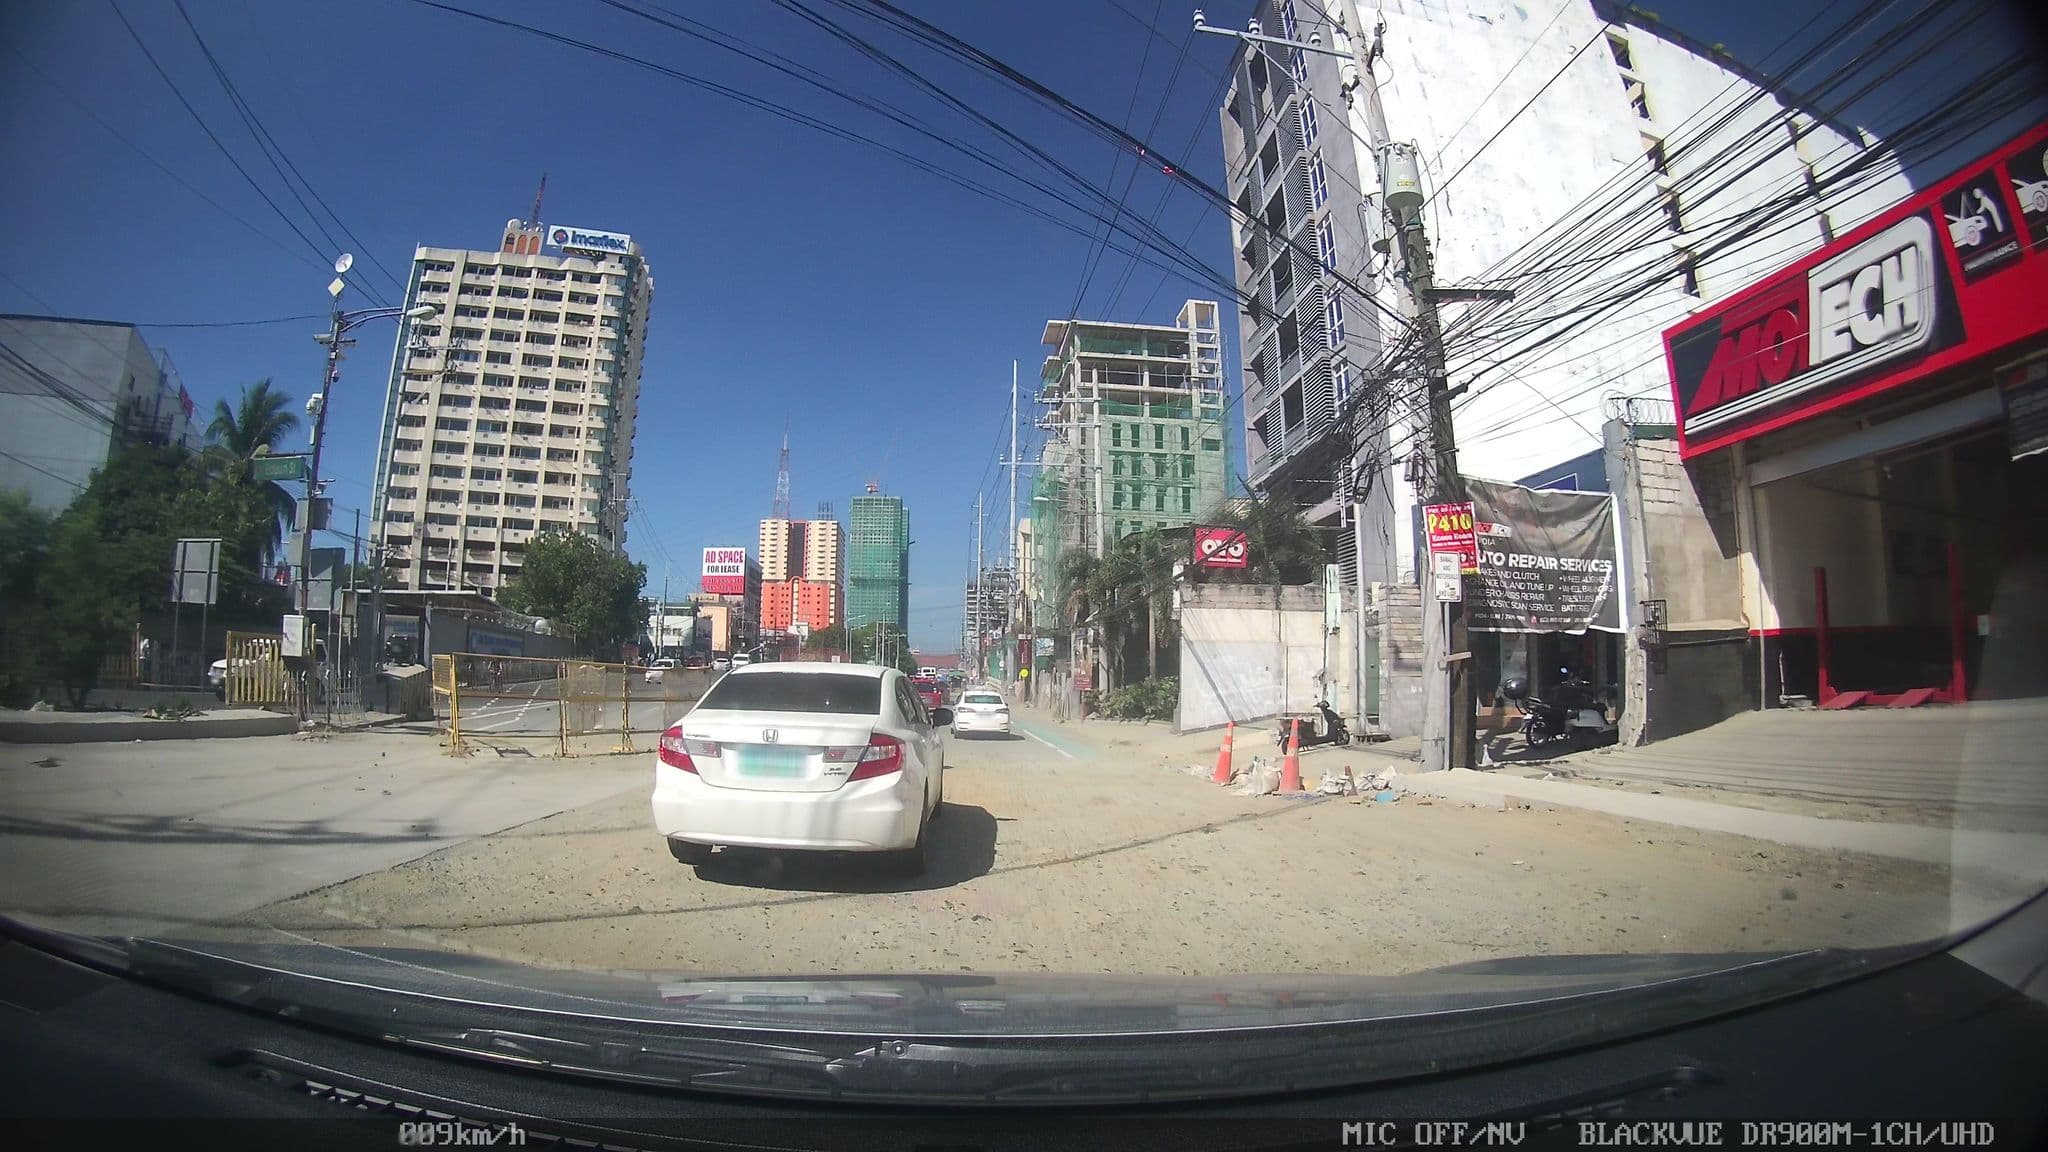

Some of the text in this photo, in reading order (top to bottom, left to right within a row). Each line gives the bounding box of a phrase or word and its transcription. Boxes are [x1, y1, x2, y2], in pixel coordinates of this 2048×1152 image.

[705, 550, 744, 564] AD SPACE
[1478, 550, 1506, 567] UTO
[1508, 553, 1558, 570] REPAIR
[1559, 558, 1613, 572] SERVICES
[707, 565, 740, 573] FOR LEASE
[1512, 571, 1540, 581] CLUTCH
[1510, 581, 1525, 590] AND
[1526, 582, 1544, 591] TUNE
[1521, 593, 1545, 601] REPAIR
[1529, 603, 1555, 612] SERVICE
